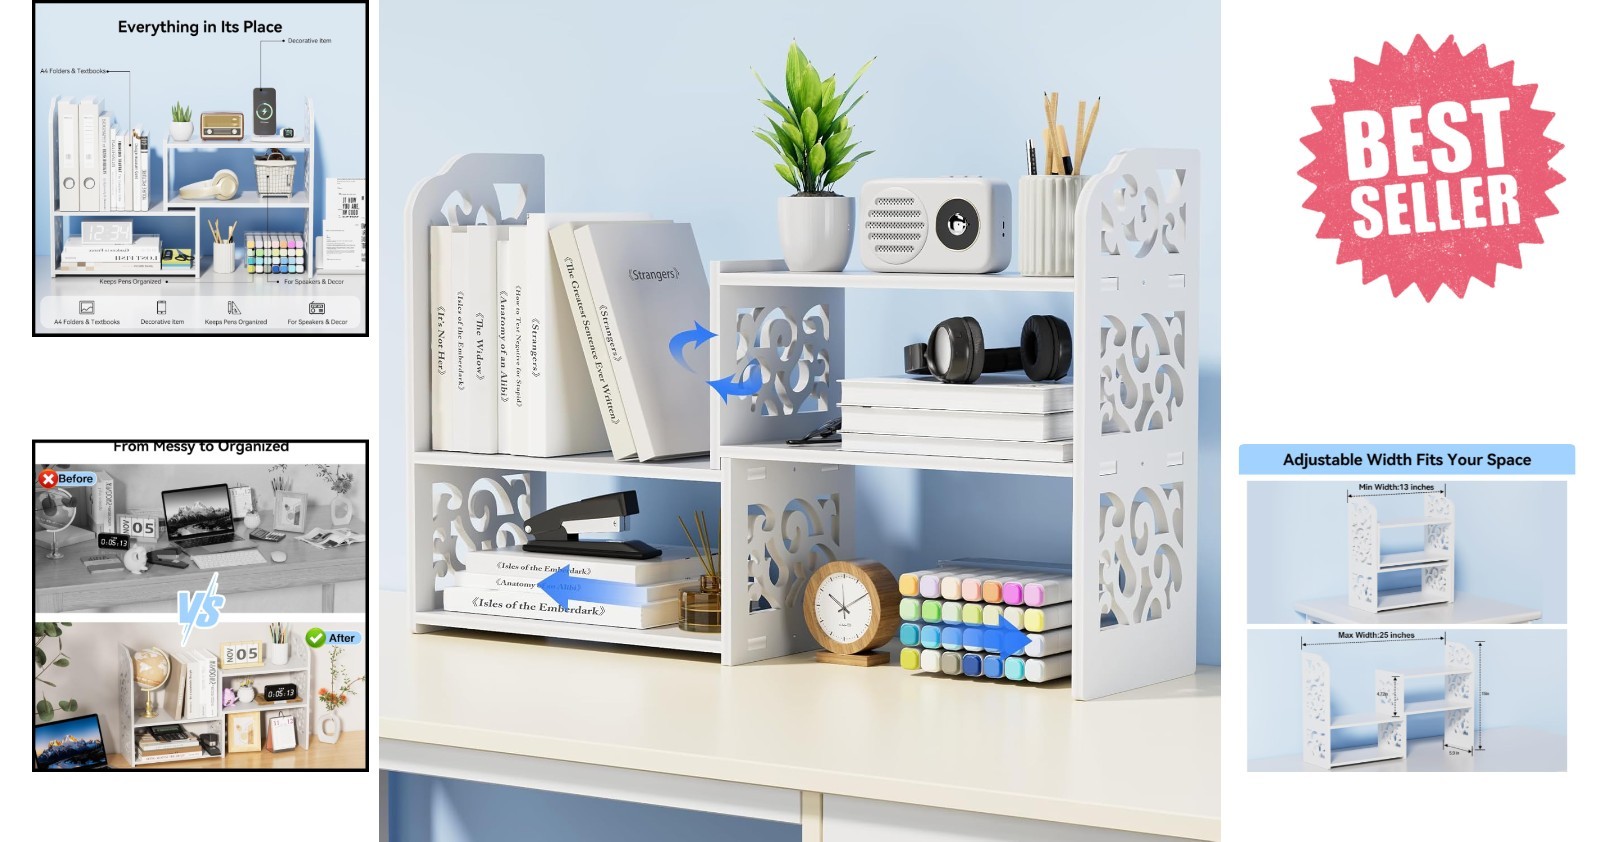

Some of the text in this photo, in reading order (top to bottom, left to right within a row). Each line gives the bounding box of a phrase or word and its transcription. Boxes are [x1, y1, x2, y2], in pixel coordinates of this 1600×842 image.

[1343, 97, 1510, 181] BEST
[1350, 174, 1521, 239] SELLER
[458, 316, 464, 326] of
[571, 280, 586, 318] Greatest
[582, 320, 598, 360] Sentence
[595, 362, 605, 383] Ever
[500, 343, 507, 355] of
[500, 357, 506, 368] an
[505, 600, 519, 609] of
[520, 601, 536, 611] the
